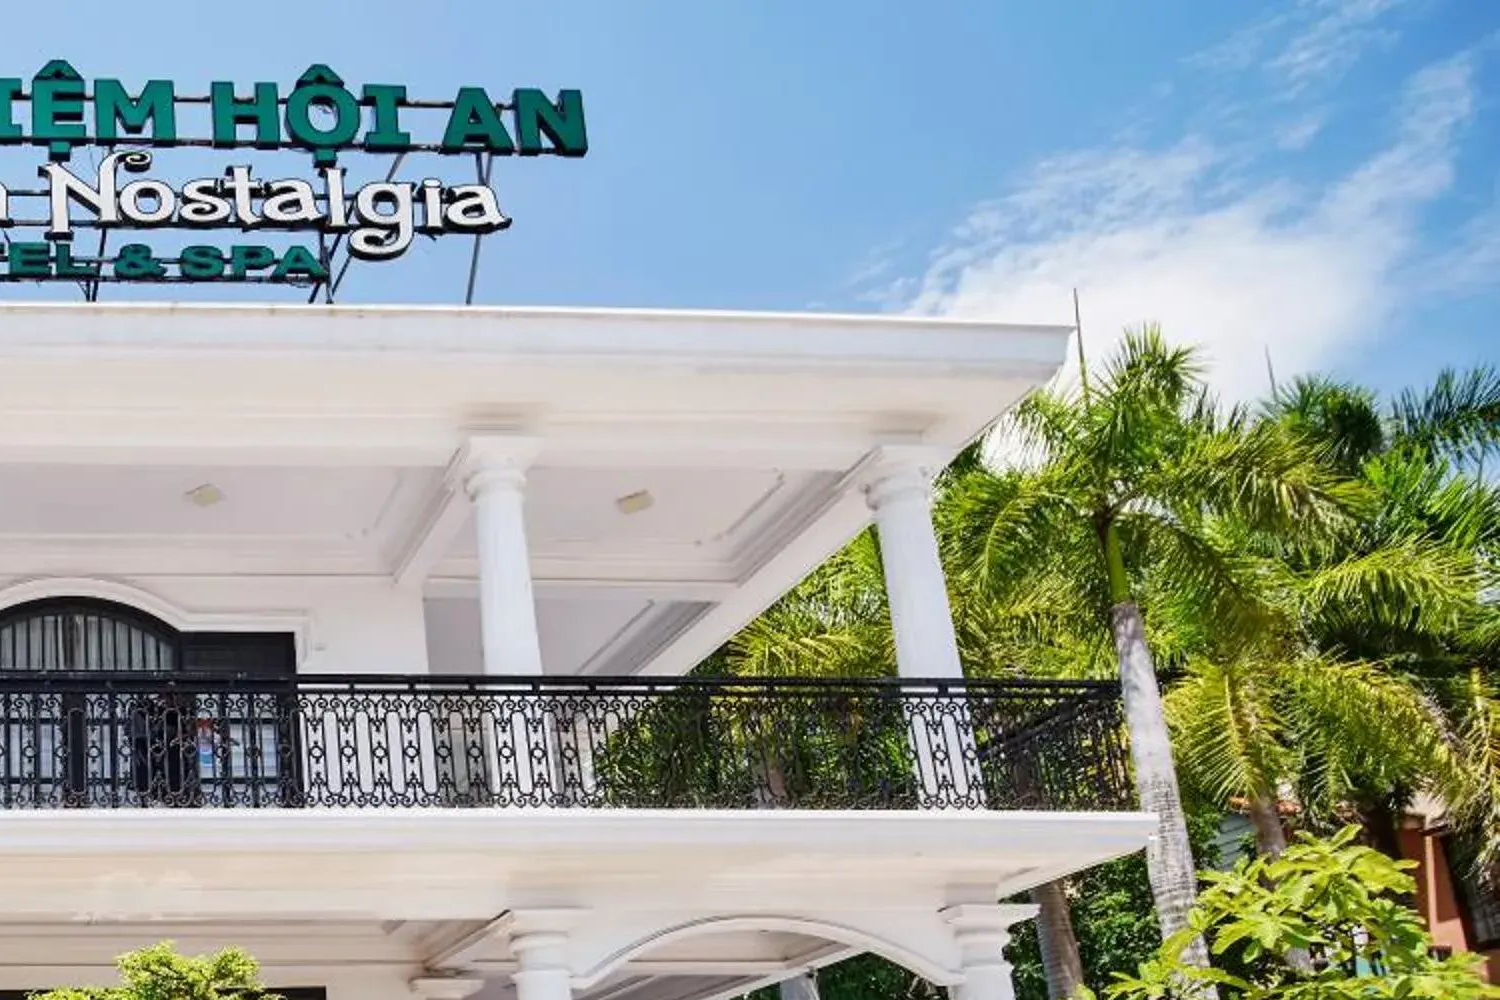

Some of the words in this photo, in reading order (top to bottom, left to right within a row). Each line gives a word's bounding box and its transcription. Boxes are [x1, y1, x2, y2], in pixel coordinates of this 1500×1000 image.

[211, 63, 411, 168] HỘI
[438, 86, 589, 157] AN
[37, 151, 513, 260] Nostalgia
[113, 243, 167, 280] &
[180, 245, 330, 280] SPA
